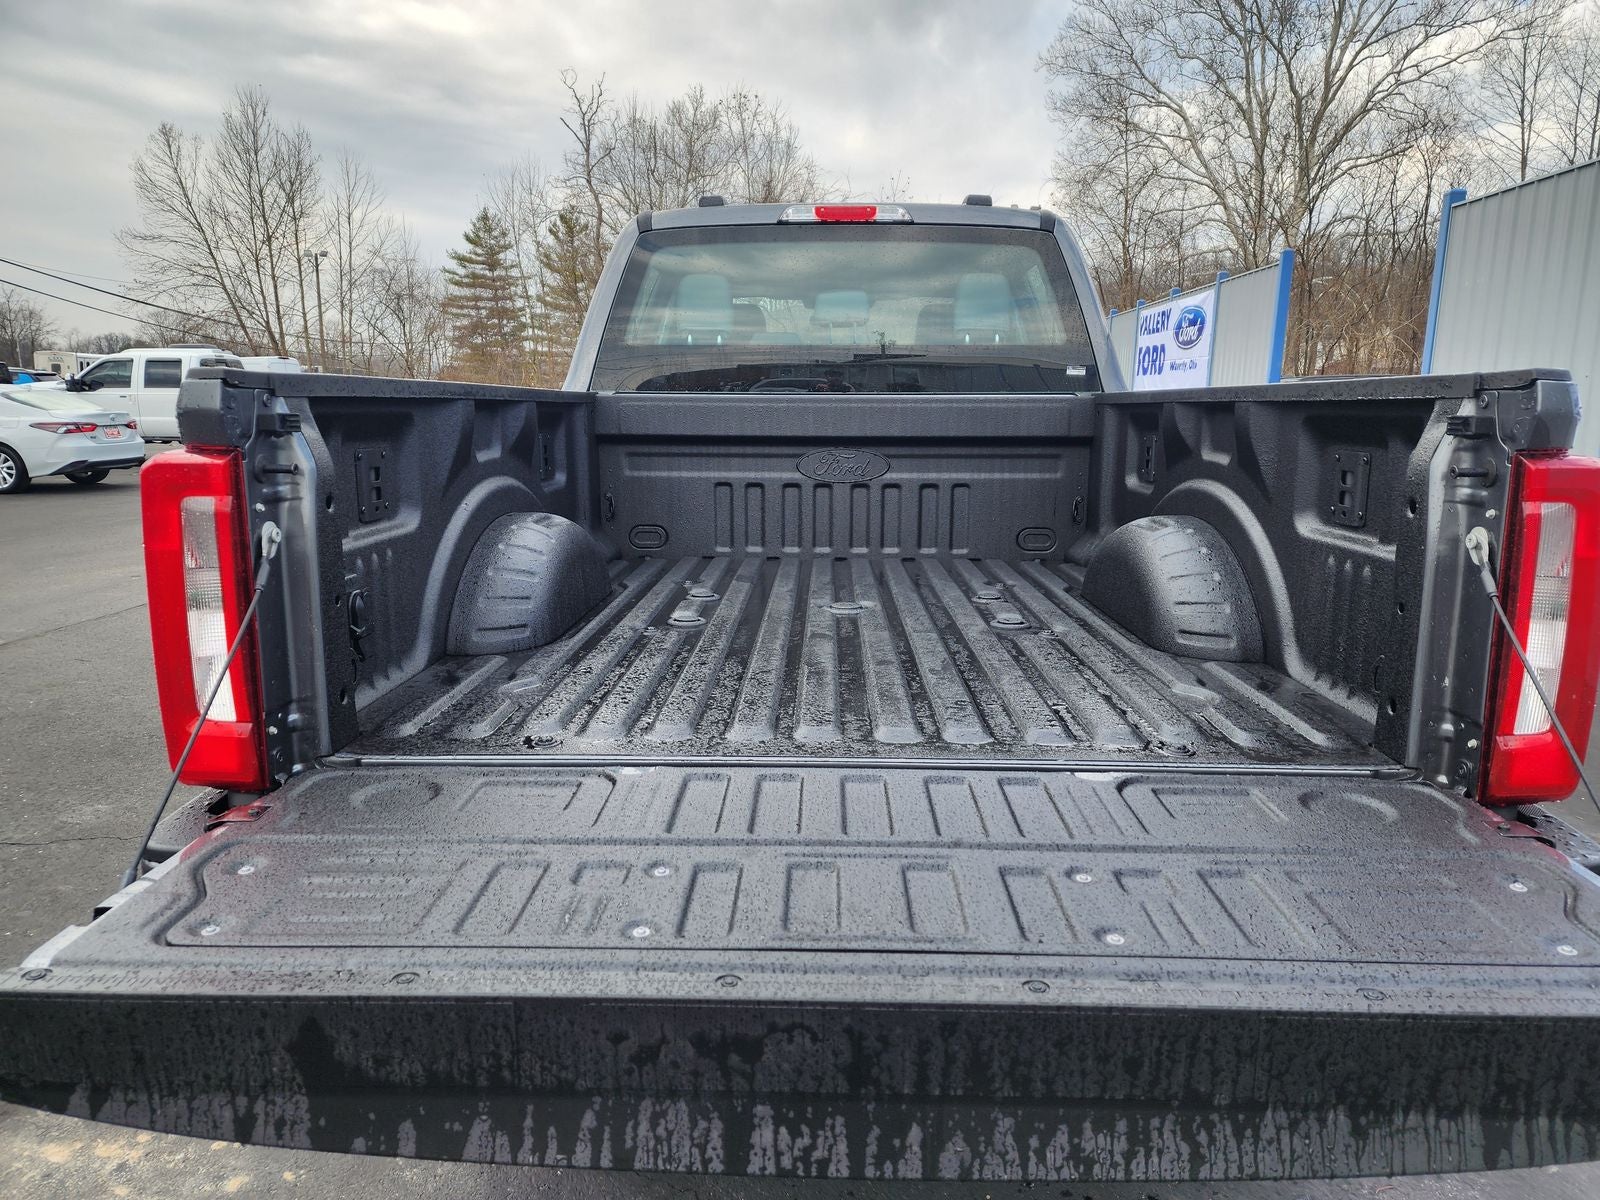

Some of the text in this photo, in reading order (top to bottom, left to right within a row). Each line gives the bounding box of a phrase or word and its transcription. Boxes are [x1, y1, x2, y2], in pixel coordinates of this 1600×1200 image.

[1179, 312, 1201, 342] Ford
[1136, 343, 1166, 376] FORD
[814, 453, 872, 476] Ford
